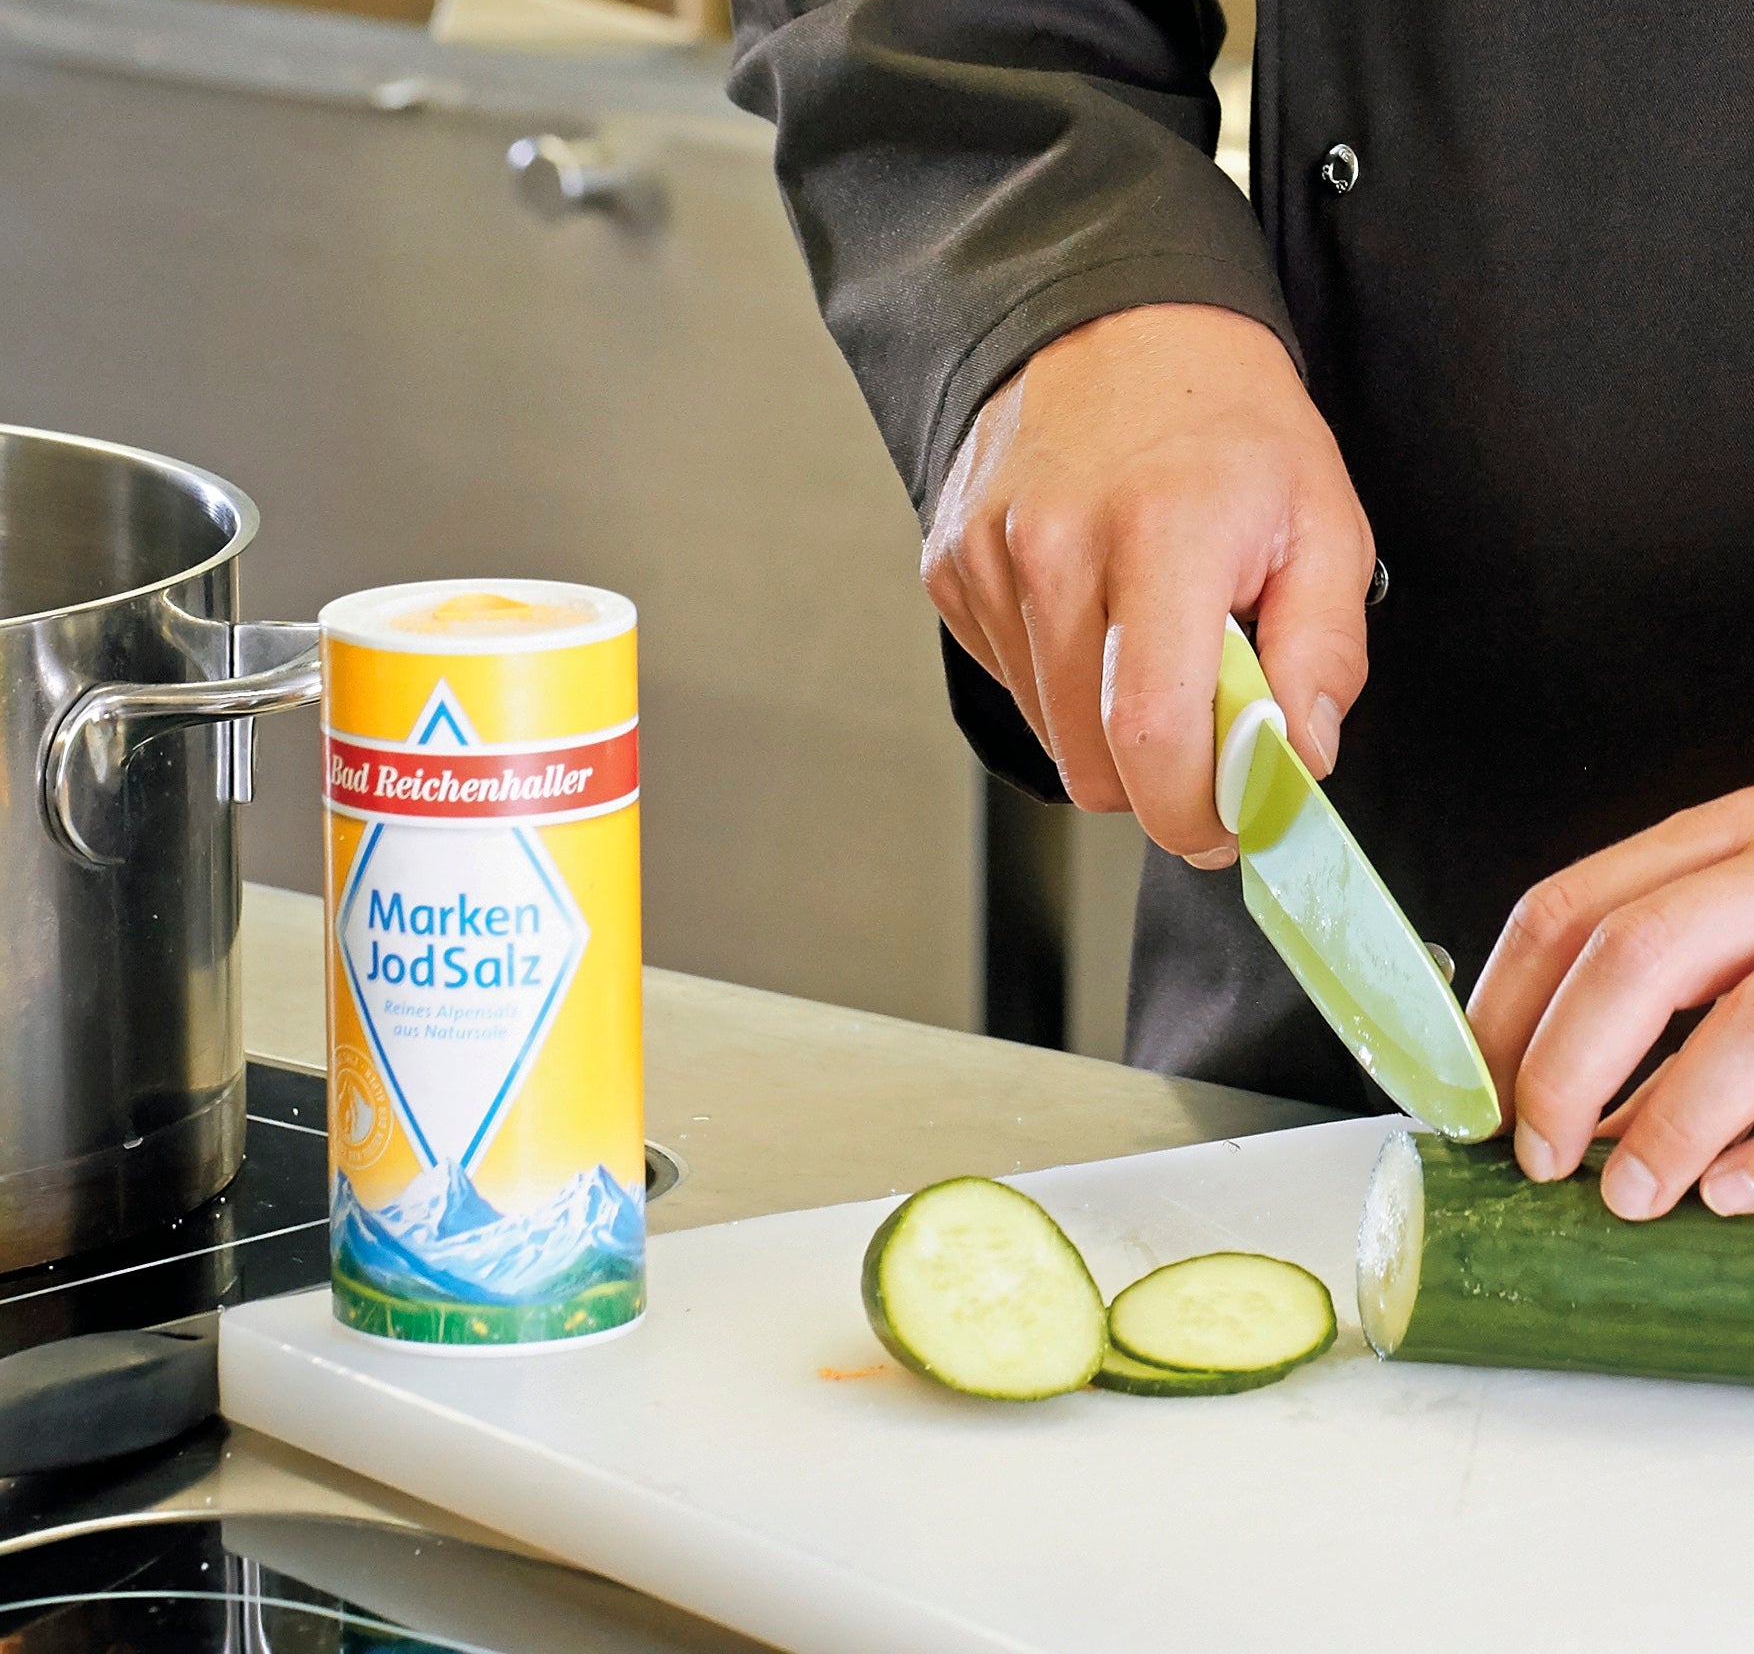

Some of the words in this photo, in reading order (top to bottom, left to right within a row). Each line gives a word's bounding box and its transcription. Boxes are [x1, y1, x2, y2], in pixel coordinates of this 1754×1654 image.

[331, 753, 370, 795] Bad
[374, 764, 594, 803] Reichenhaller
[367, 888, 540, 937] Marken
[366, 941, 541, 989] JodSalz
[384, 999, 432, 1019] Reines
[393, 1024, 419, 1038] aus
